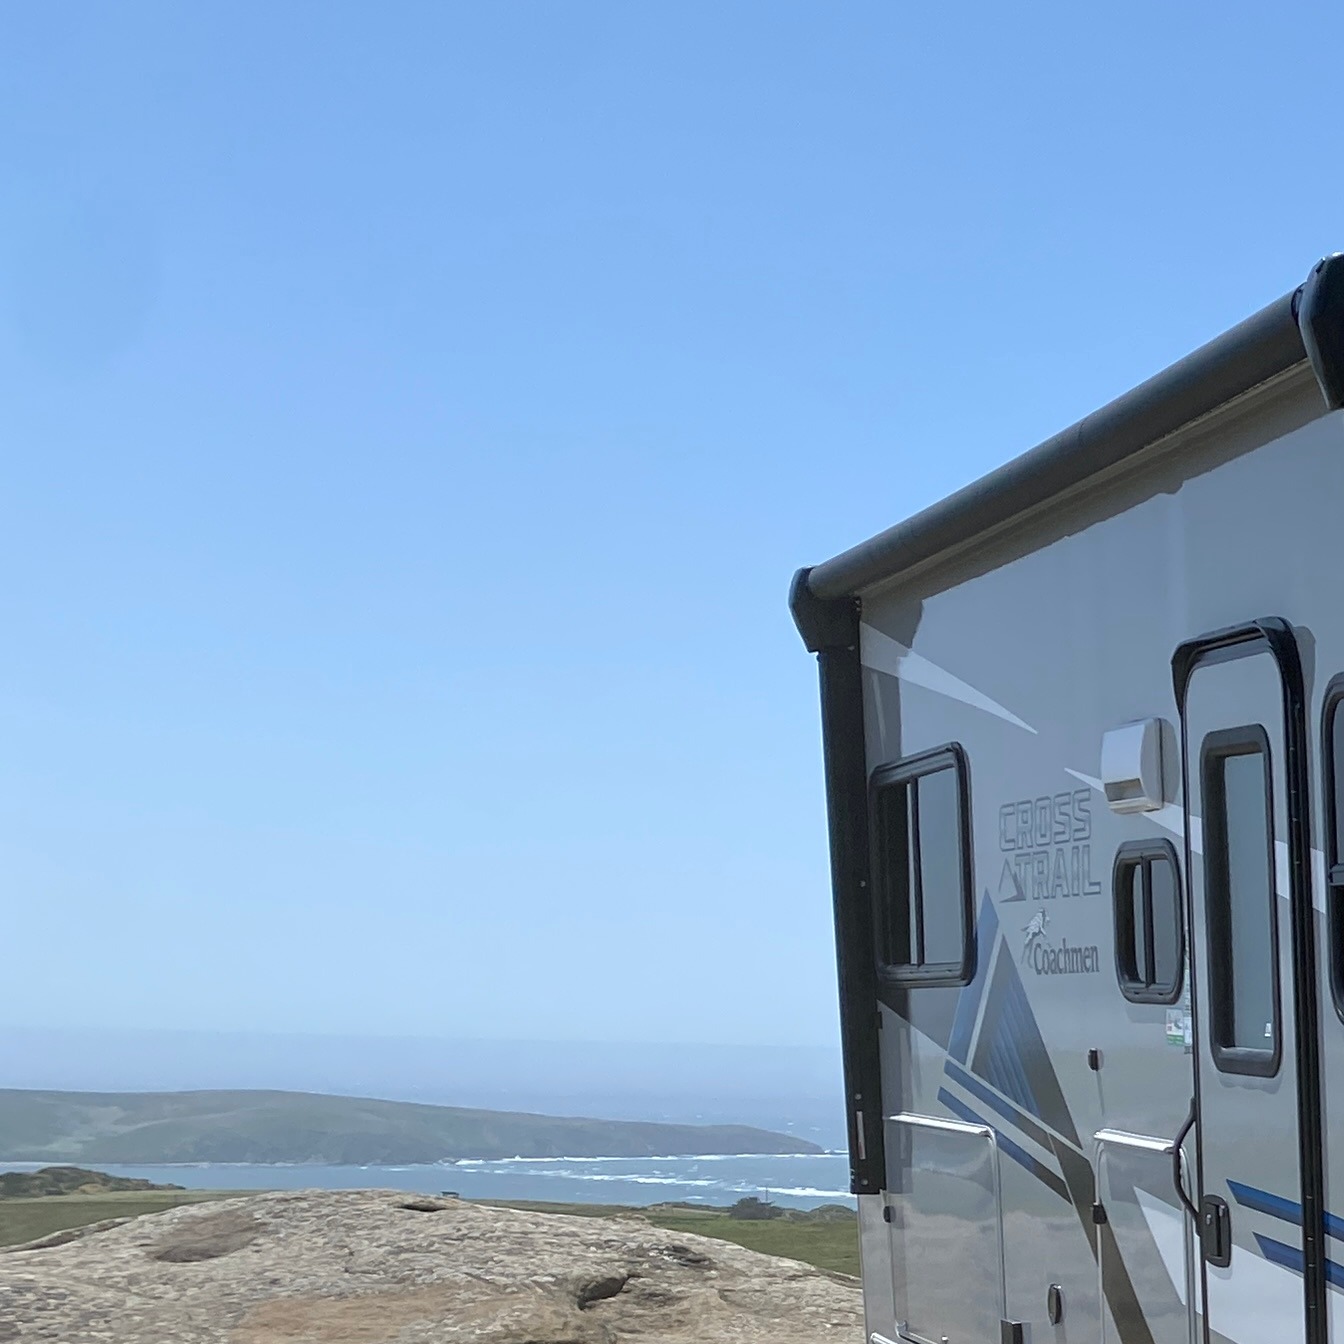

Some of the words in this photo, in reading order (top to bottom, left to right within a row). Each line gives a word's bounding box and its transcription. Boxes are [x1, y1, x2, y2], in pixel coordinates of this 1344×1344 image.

[999, 787, 1092, 852] CROSS
[1014, 844, 1102, 900] TRAIL
[1033, 937, 1100, 976] Coachmen
